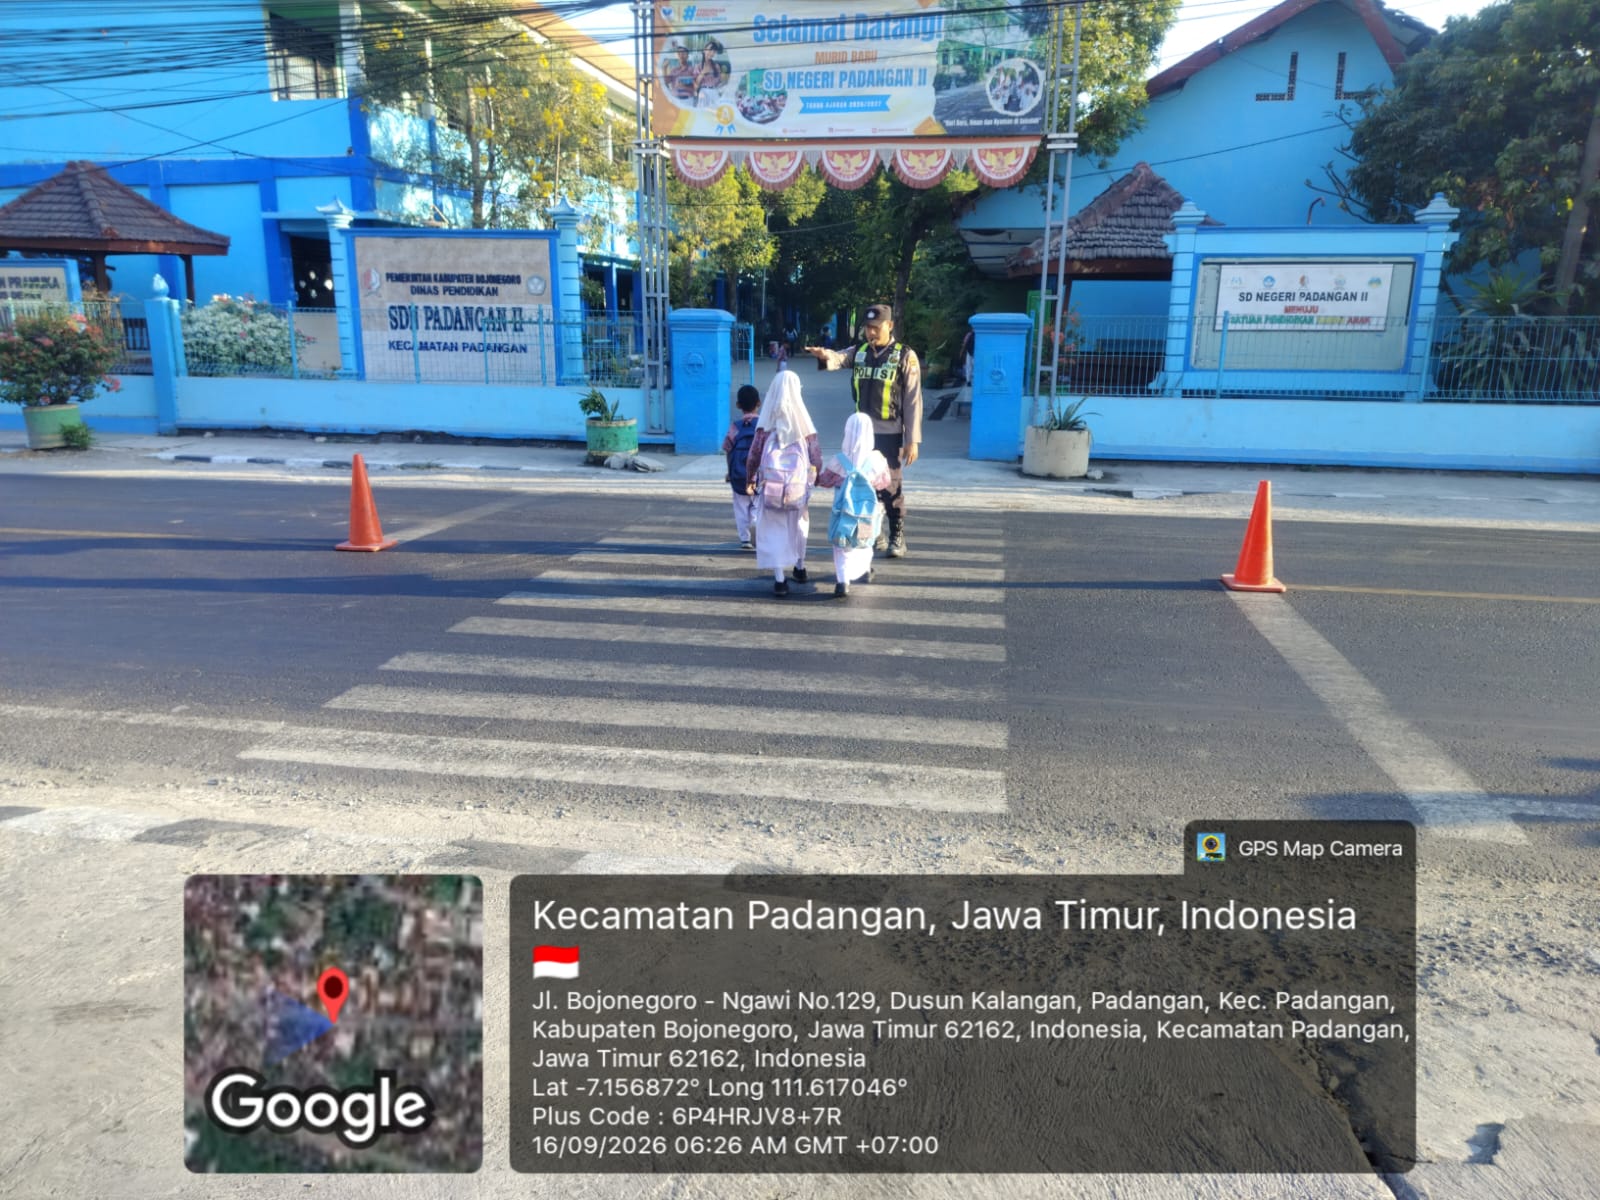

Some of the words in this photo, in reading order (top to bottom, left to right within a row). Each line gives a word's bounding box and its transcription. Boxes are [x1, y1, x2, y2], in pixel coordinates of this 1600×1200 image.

[753, 13, 846, 43] Selamat
[815, 51, 848, 64] MURID
[764, 71, 783, 89] SD
[786, 70, 834, 89] NEGERI
[839, 68, 914, 88] PADANGAN
[917, 67, 927, 86] II
[386, 272, 432, 283] PEMERINTAH
[433, 273, 474, 283] KABUPATEN
[476, 273, 522, 285] BOJONEGORO
[410, 285, 439, 296] DINAS
[442, 285, 499, 297] PENDIDIKAN
[1238, 291, 1253, 302] SD
[1256, 291, 1296, 302] NEGERI
[1299, 291, 1358, 302] PADANGAN
[1361, 291, 1369, 302] II
[1284, 304, 1319, 314] MENUJU
[423, 305, 507, 332] PADANGAN
[511, 306, 524, 332] II
[462, 342, 528, 353] PADANGAN
